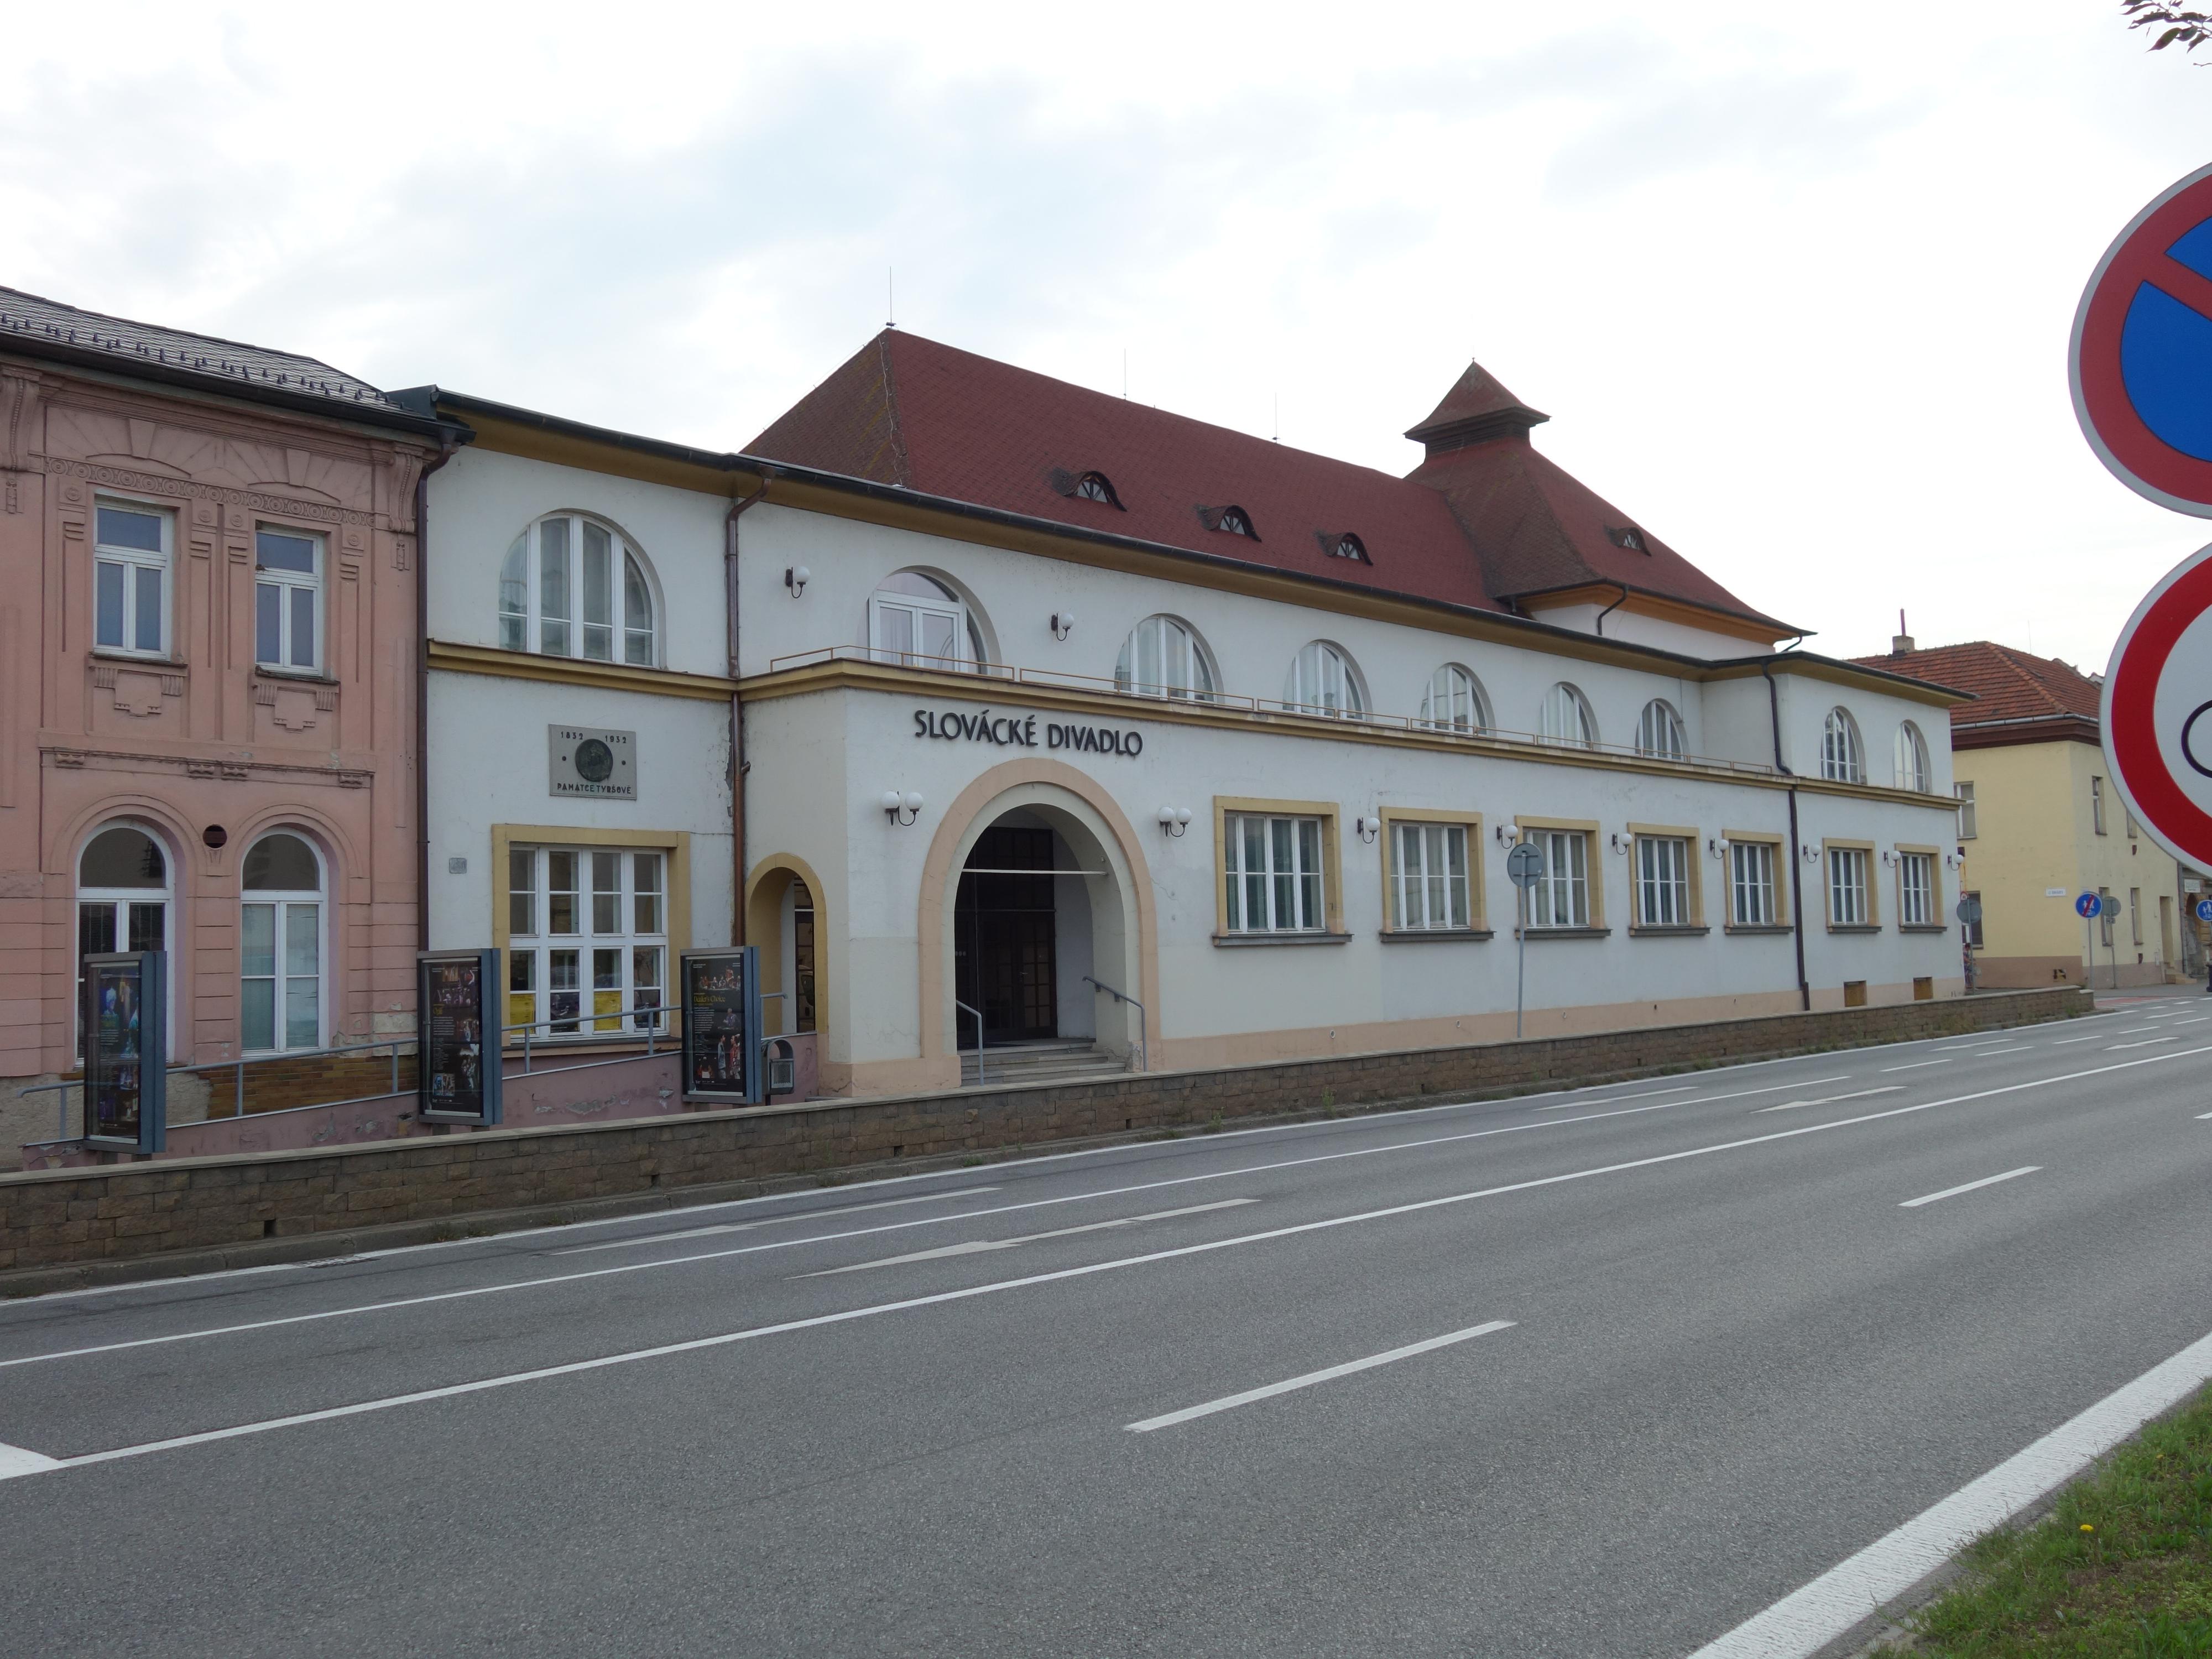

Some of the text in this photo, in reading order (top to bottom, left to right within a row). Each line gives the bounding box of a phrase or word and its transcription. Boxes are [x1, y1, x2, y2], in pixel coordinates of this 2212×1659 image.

[561, 731, 626, 743] 1832 1932
[914, 709, 1143, 756] SLOVÁCKÉ DIVADLO
[557, 782, 594, 792] PAMÁTCE
